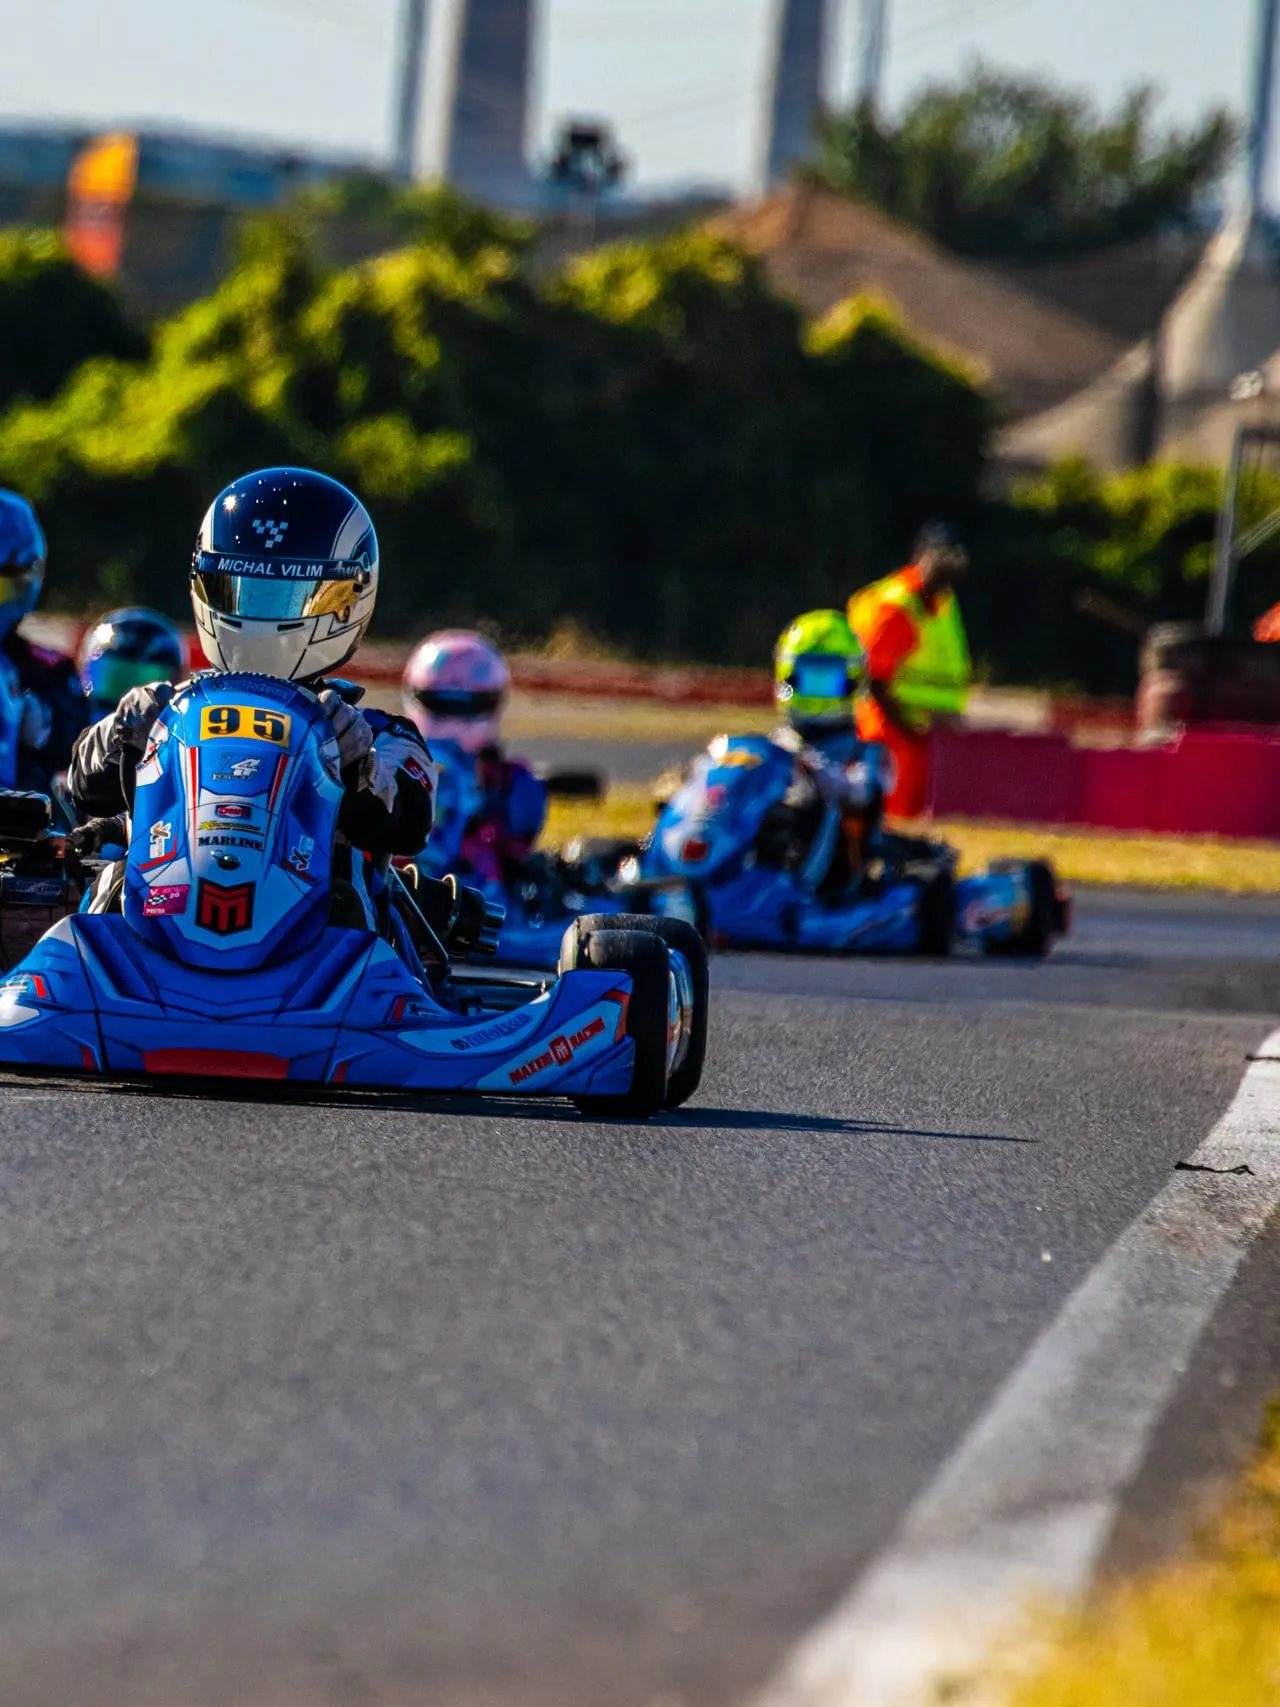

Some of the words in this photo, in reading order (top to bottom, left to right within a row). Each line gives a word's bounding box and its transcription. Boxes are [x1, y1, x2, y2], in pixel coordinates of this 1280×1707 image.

[218, 557, 275, 576] MICHAL
[281, 564, 324, 578] VILIM
[208, 706, 285, 743] 95
